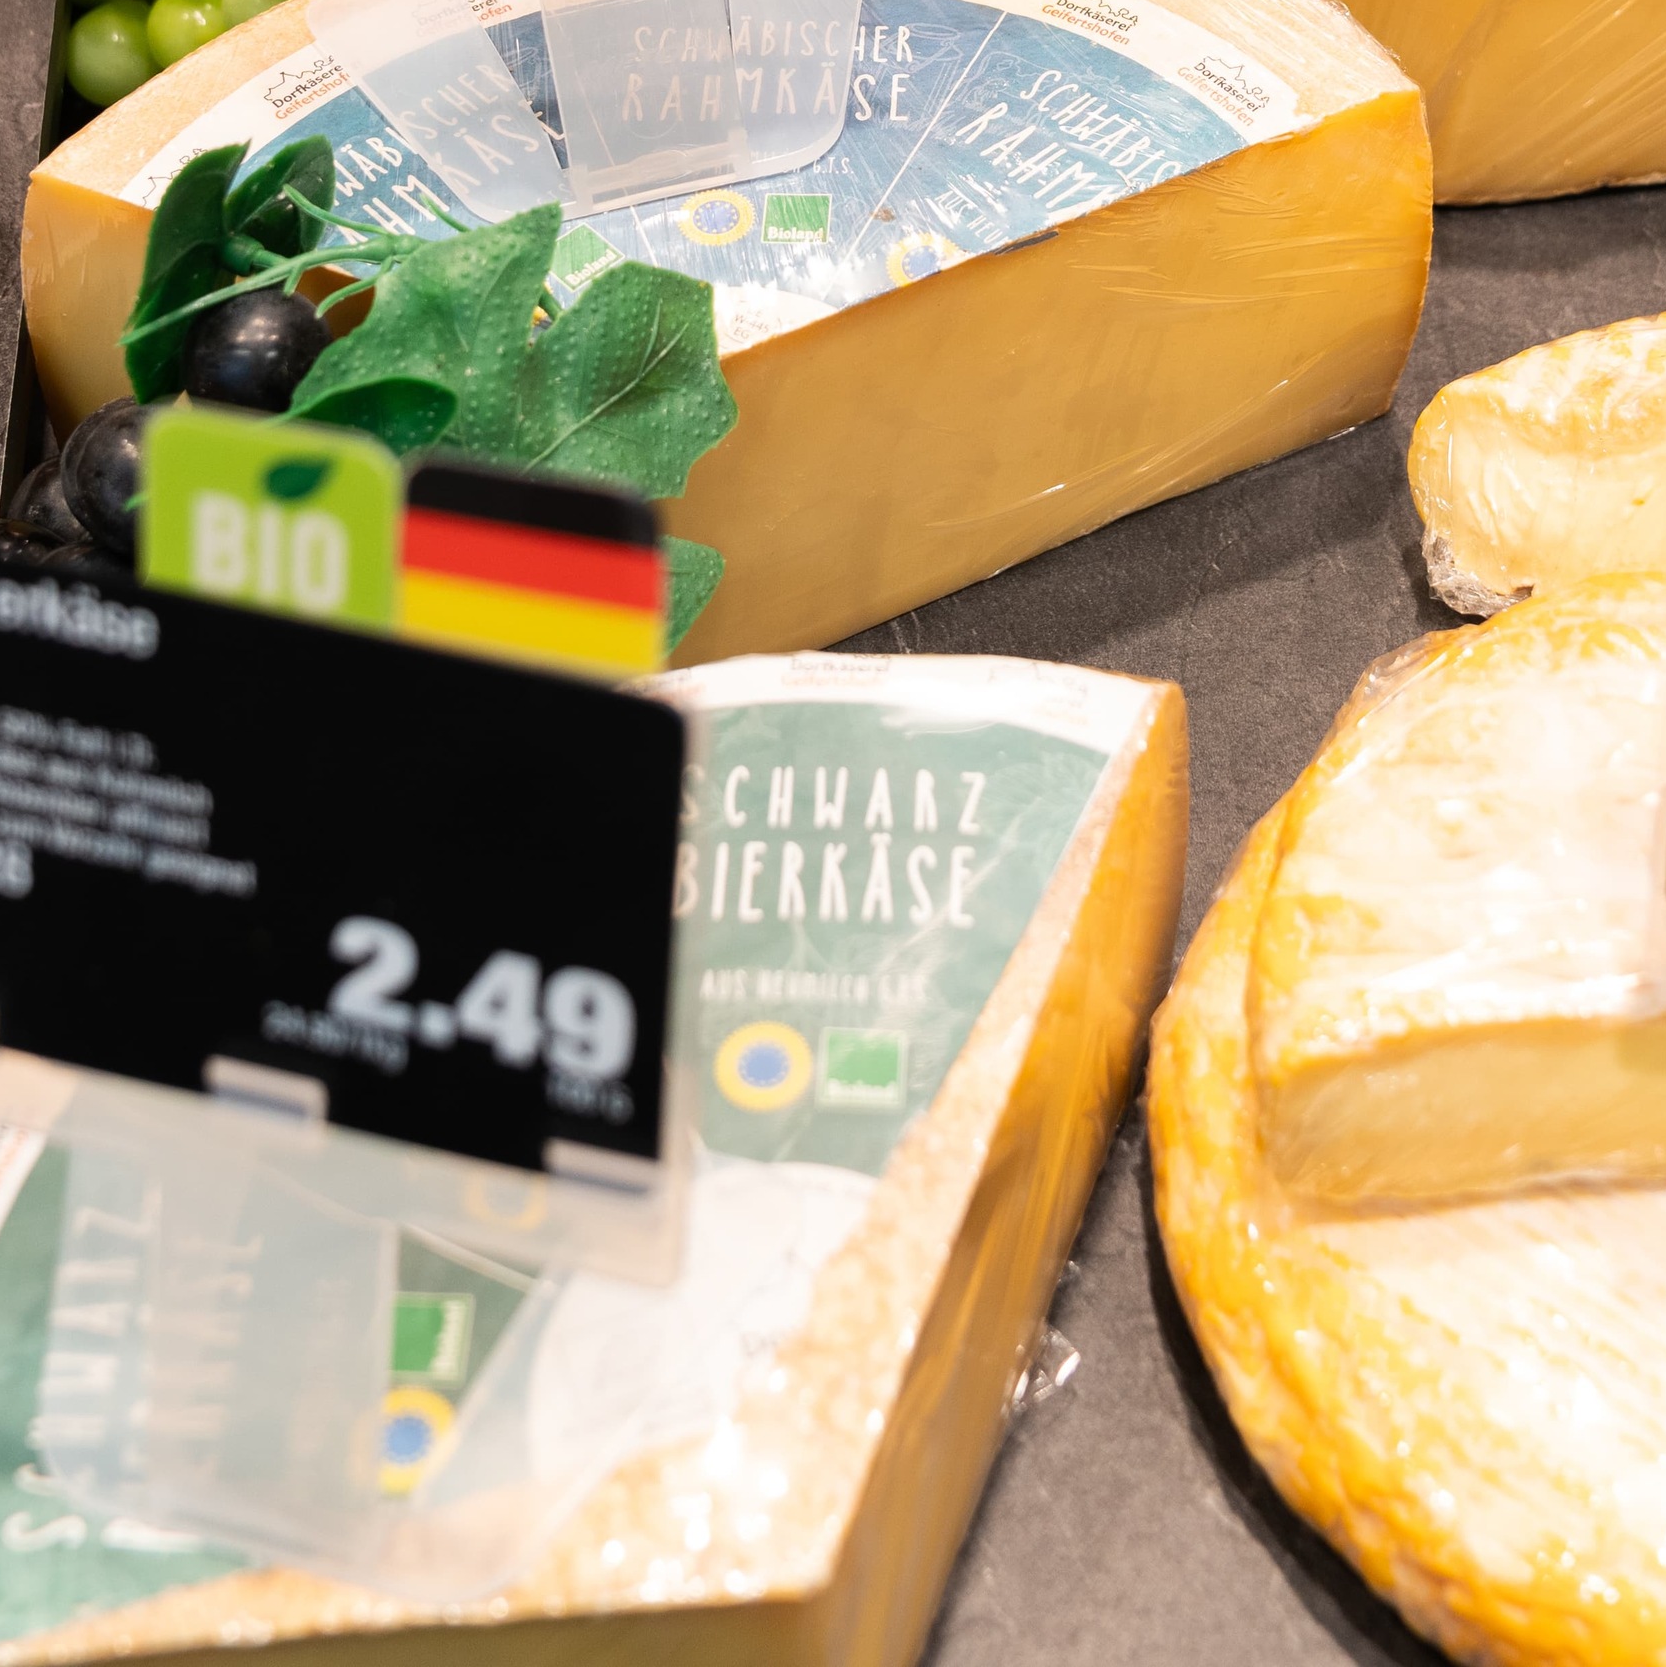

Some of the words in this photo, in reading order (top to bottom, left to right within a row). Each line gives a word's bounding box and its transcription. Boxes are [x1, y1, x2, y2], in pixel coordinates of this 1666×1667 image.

[1041, 4, 1131, 46] Geifertshofen
[1176, 66, 1255, 128] Geifertshofen
[1193, 61, 1266, 113] Dorfkäserei
[767, 226, 824, 241] Bioland
[189, 489, 349, 616] BIO
[673, 833, 977, 929] BIERKÄSE
[327, 915, 637, 1085] 2.49
